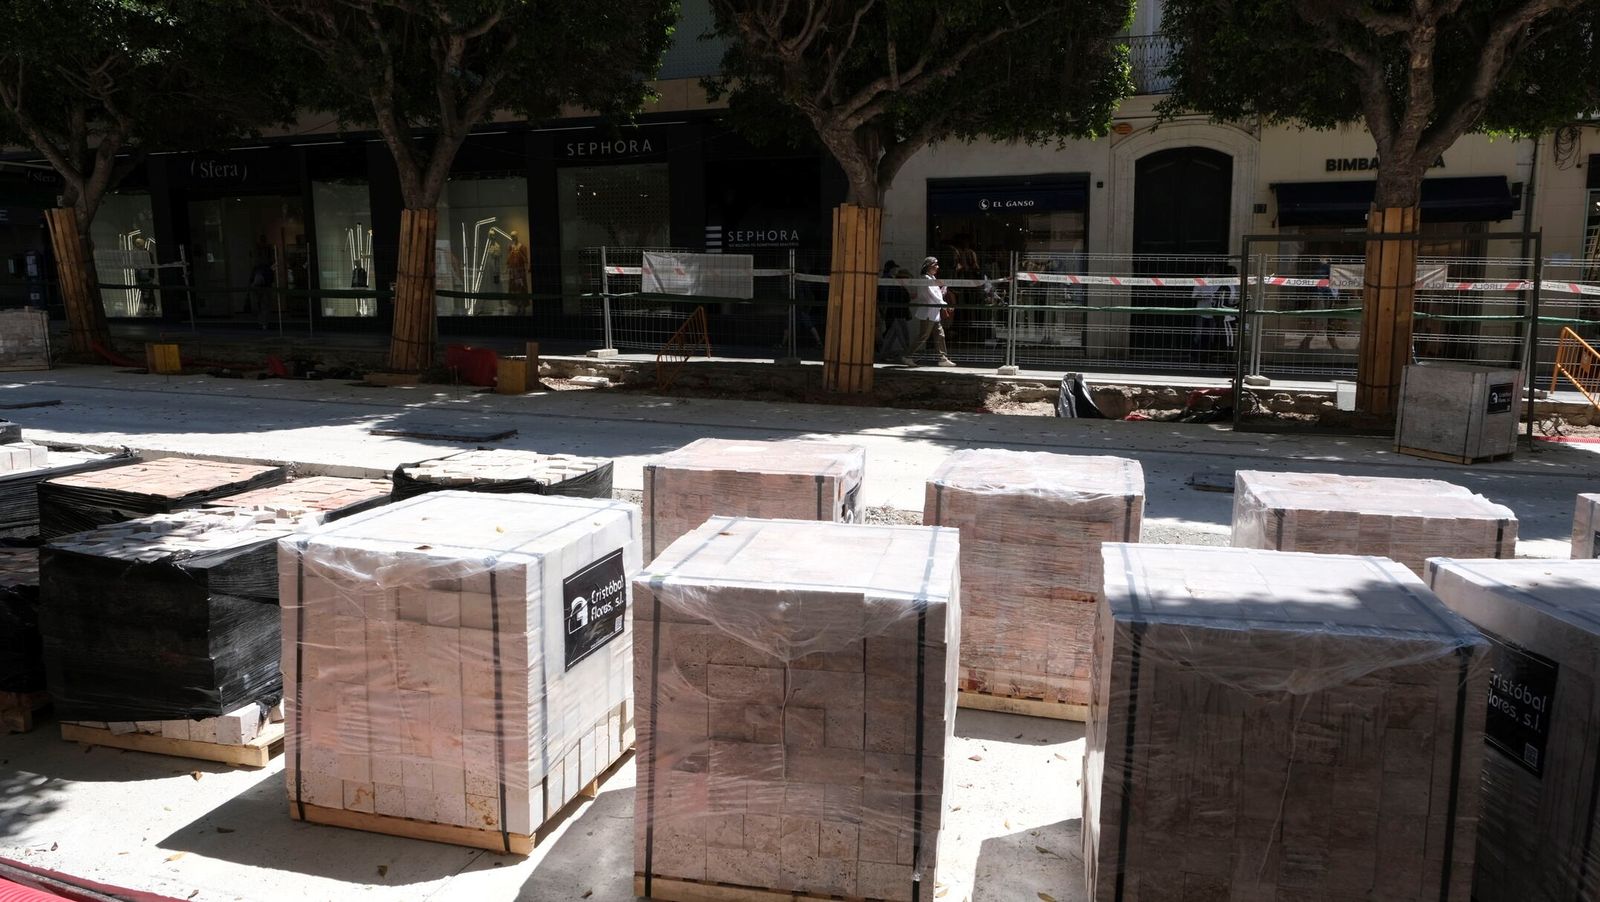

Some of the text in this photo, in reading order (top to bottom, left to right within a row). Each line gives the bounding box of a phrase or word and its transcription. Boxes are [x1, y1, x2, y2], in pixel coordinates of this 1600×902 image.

[567, 138, 653, 157] SEPHORA
[1325, 157, 1380, 172] BIMBA
[1005, 199, 1035, 208] GANSO
[727, 229, 800, 242] SEPHORA
[591, 574, 624, 604] Cristóbal
[1488, 687, 1519, 722] lores,
